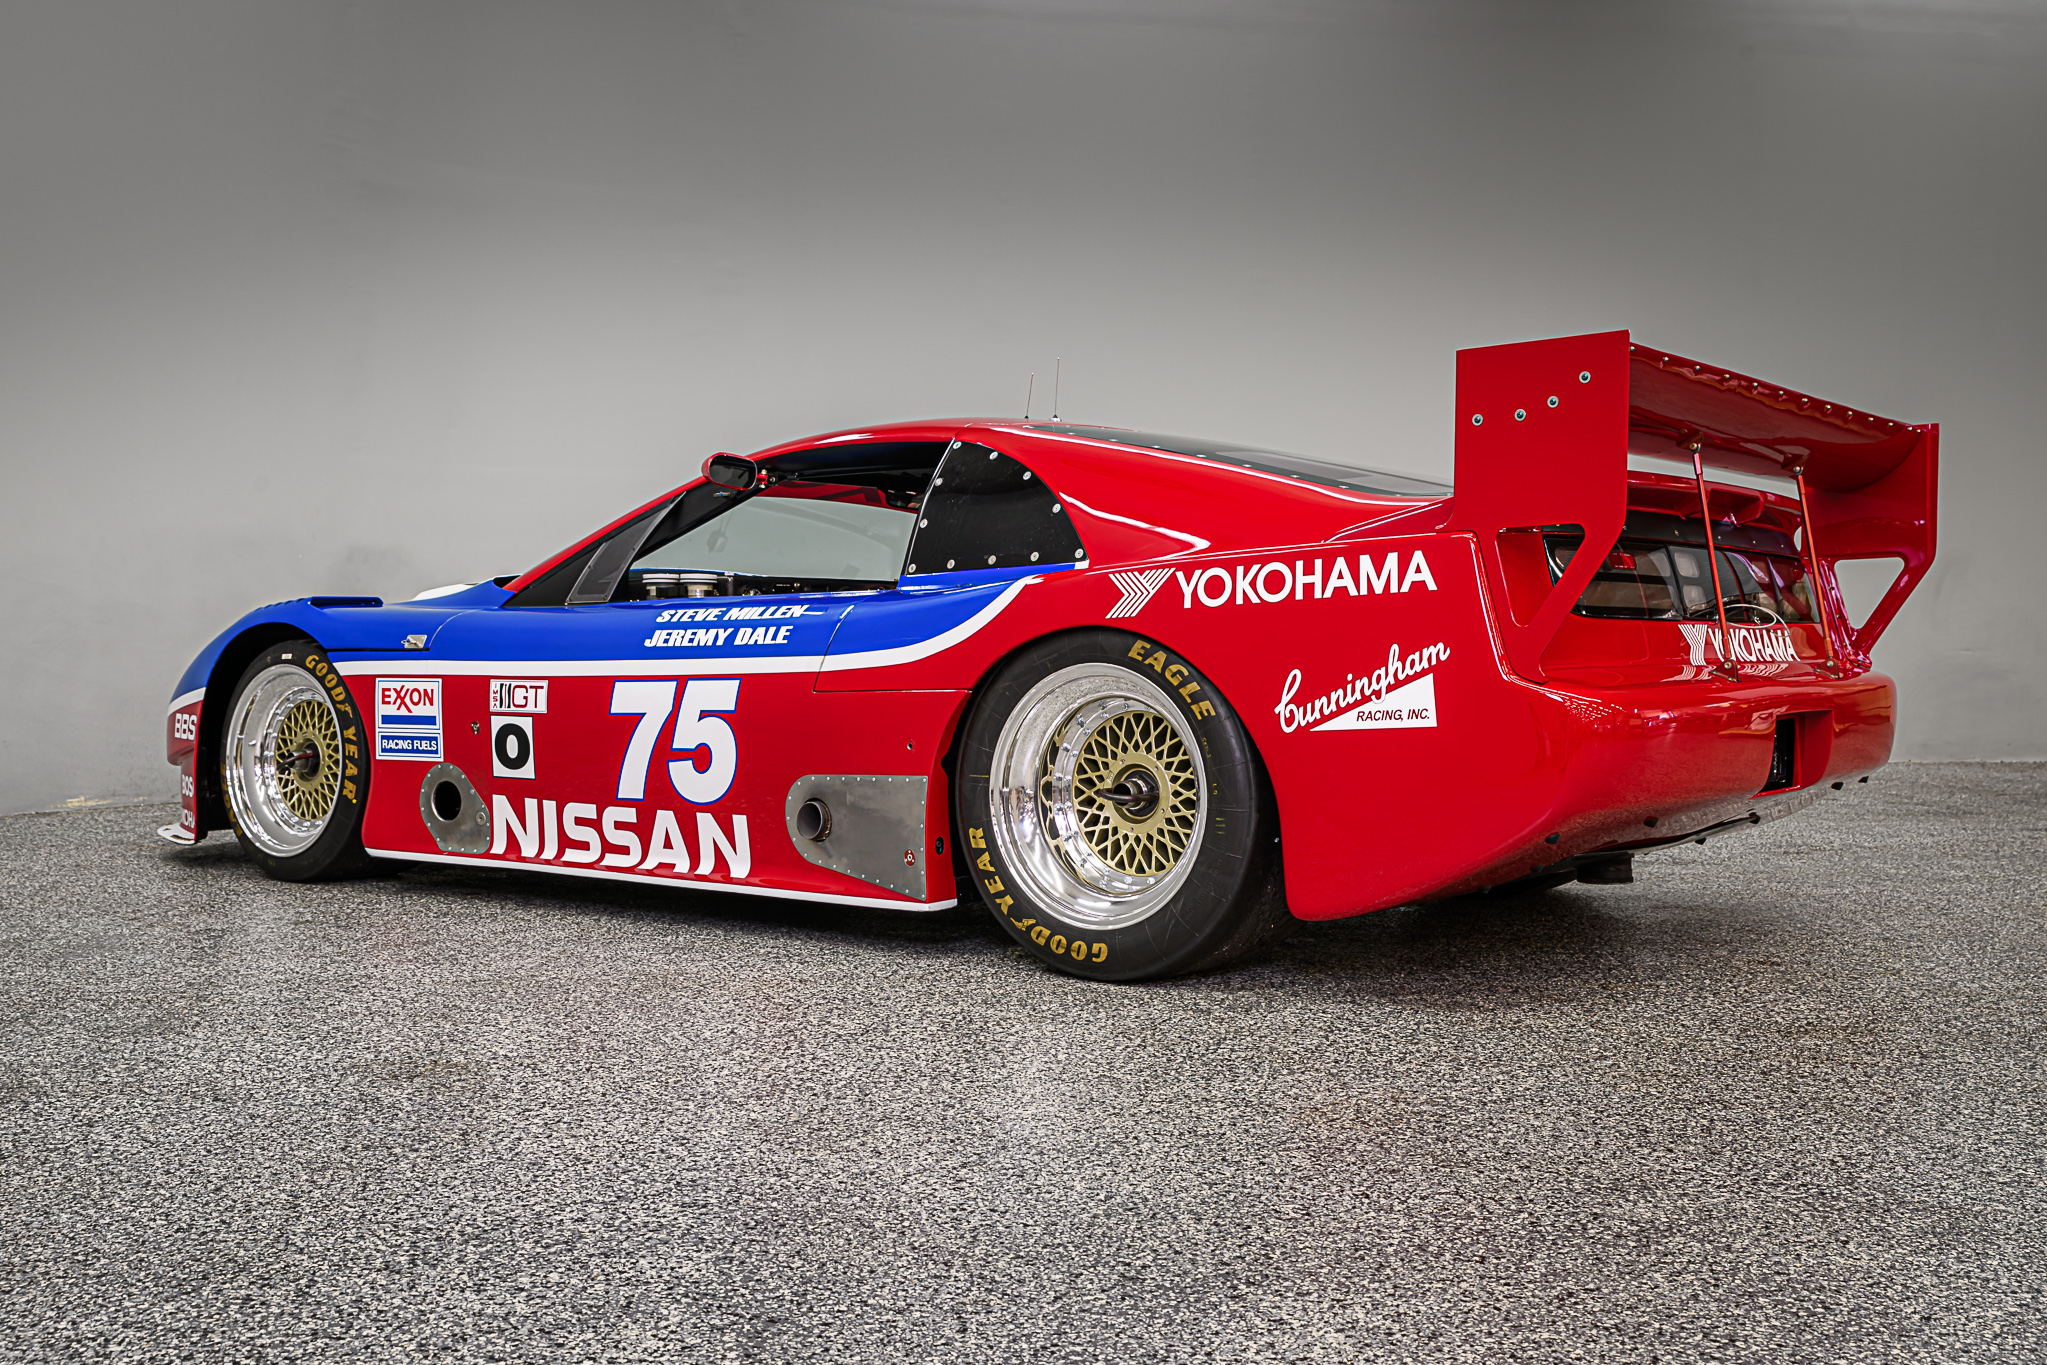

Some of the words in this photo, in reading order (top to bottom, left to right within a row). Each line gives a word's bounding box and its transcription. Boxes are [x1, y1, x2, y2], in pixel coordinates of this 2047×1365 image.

[1175, 550, 1438, 609] YOKOHAMA
[656, 608, 726, 622] STEVE
[723, 605, 810, 621] MILLEN
[644, 628, 734, 648] JEREMY
[734, 626, 793, 645] DALE
[1708, 628, 1801, 662] YOKOHAMA
[1127, 639, 1216, 720] EAGLE
[1274, 641, 1451, 733] Cunningham
[381, 685, 434, 713] EXXON
[512, 685, 544, 709] GT
[174, 713, 198, 740] BBS
[1356, 709, 1404, 722] RACING,
[1407, 708, 1430, 720] INC.
[382, 739, 412, 750] RACING
[415, 740, 437, 751] FUELS
[609, 677, 742, 806] 75
[182, 774, 195, 798] BOS
[490, 794, 752, 879] NISSAN
